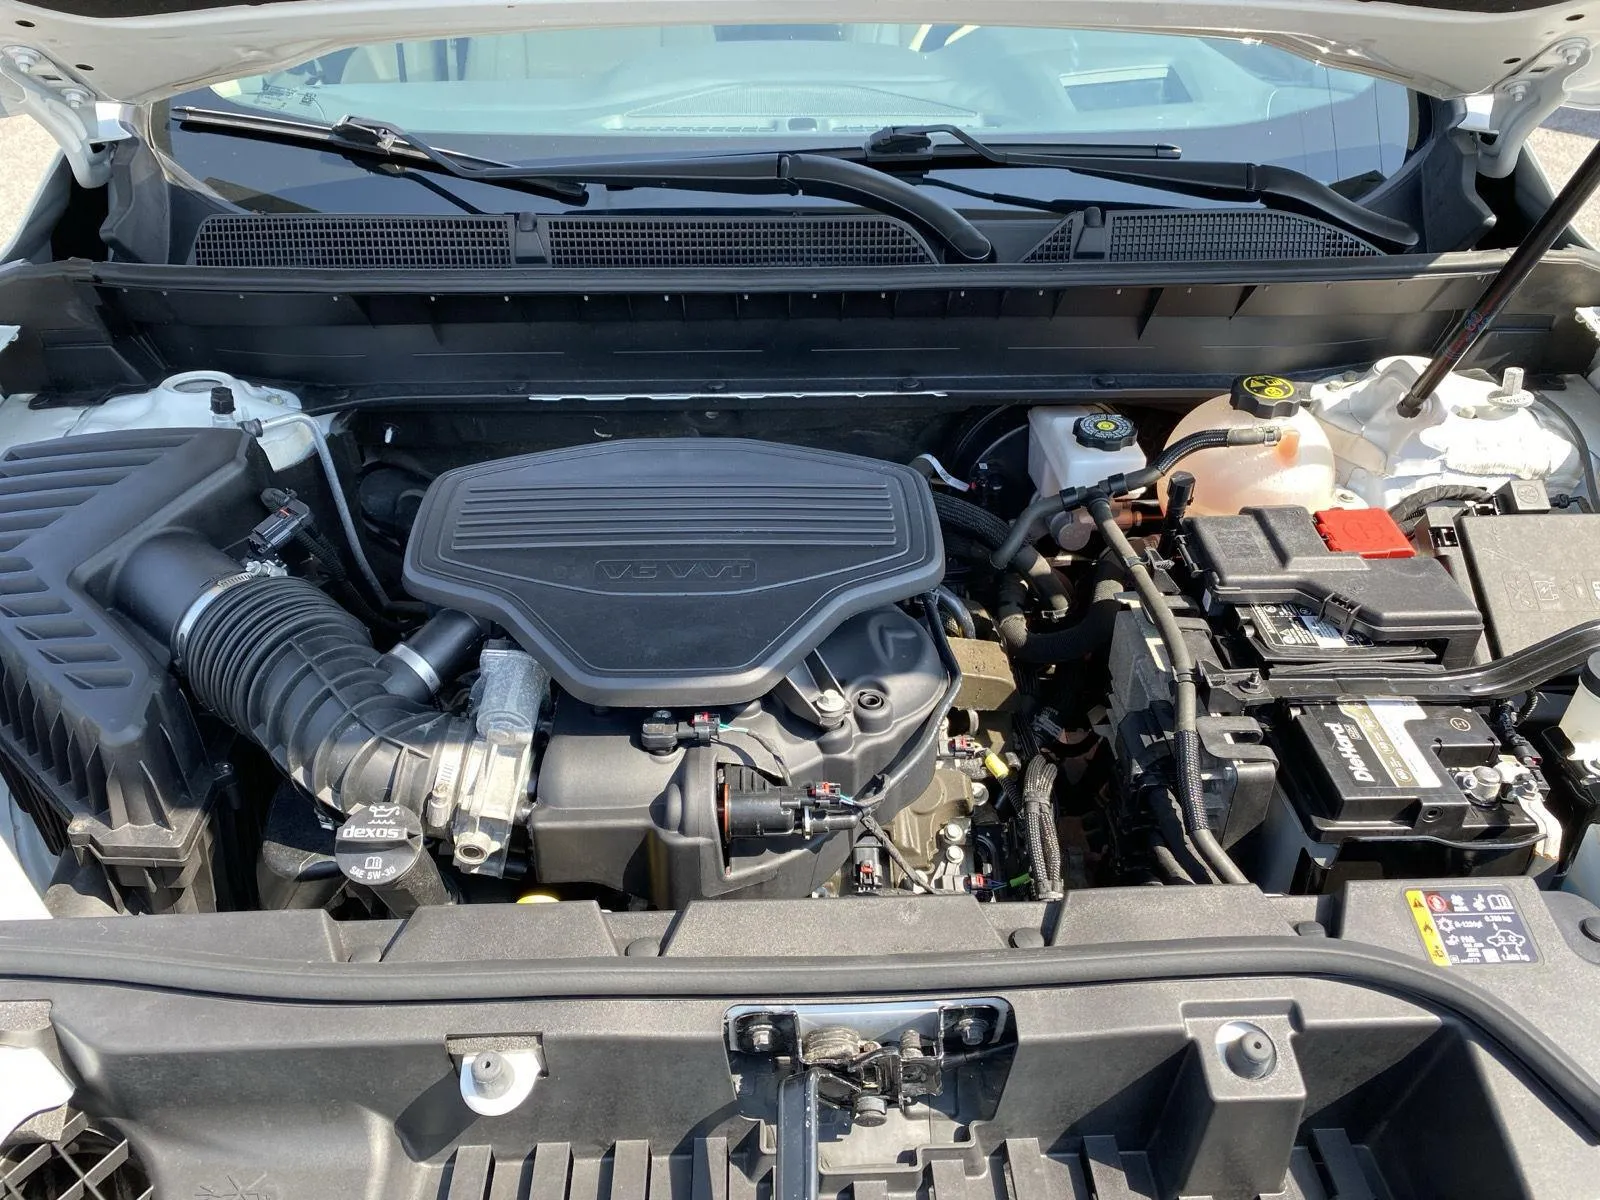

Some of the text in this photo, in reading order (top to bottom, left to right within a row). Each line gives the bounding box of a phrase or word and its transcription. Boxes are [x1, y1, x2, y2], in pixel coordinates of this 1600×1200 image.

[601, 562, 750, 579] V6 VVT
[1323, 721, 1376, 783] DieHard
[342, 825, 399, 838] dexos
[349, 866, 397, 880] SAE 5W-30
